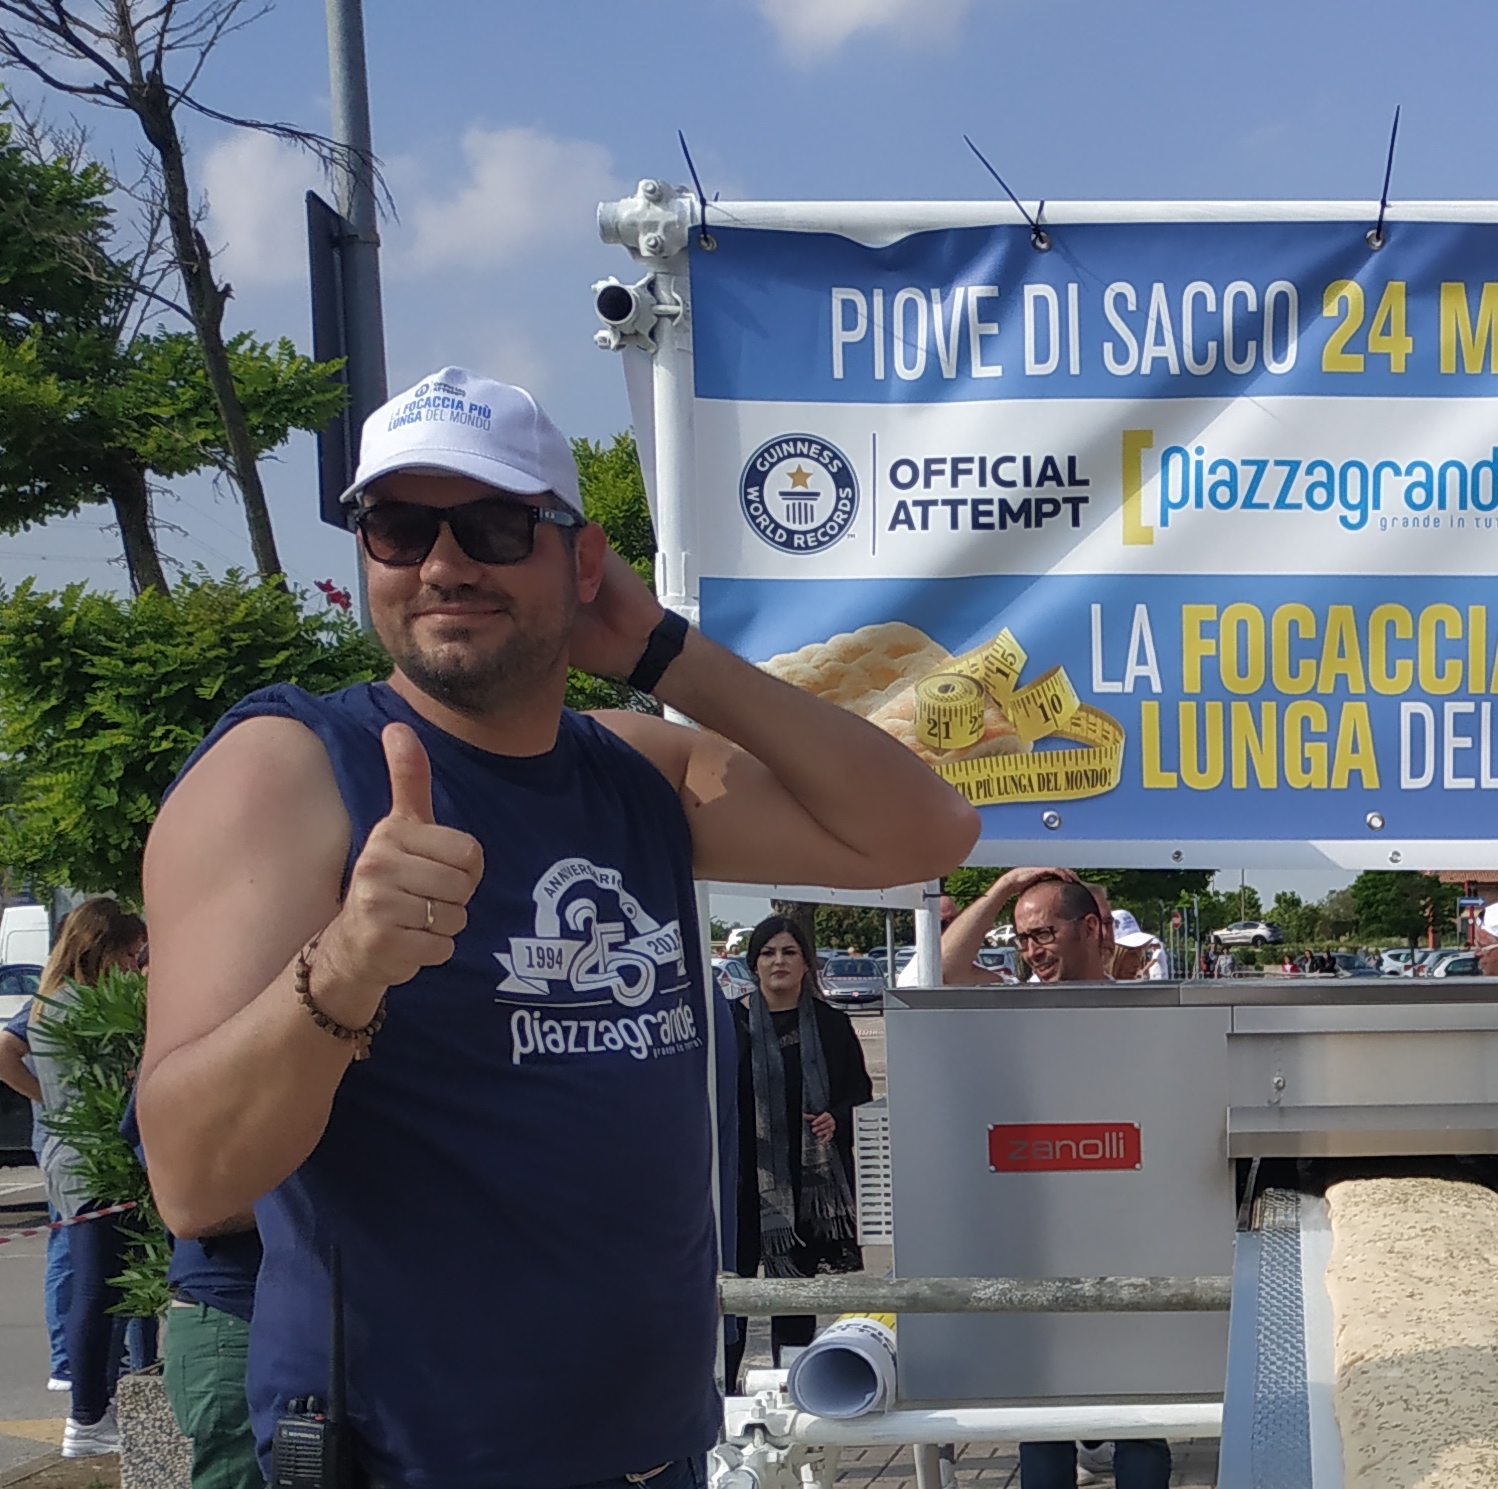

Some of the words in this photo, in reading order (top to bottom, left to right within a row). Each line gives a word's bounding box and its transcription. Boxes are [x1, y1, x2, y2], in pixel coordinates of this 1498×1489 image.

[831, 285, 1002, 380] PIOVE
[1023, 282, 1079, 377] DI
[1103, 280, 1299, 376] SACCO
[1322, 279, 1413, 374] 24
[387, 411, 422, 432] LUNGA
[426, 409, 445, 422] DEL
[450, 410, 491, 431] MONDO
[403, 396, 464, 414] FOCACCIA
[469, 402, 492, 419] PIÙ
[756, 441, 842, 473] GUINNESS
[889, 455, 1090, 490] OFFICIAL
[746, 486, 787, 543] WORLD
[793, 487, 853, 548] RECORDS
[887, 497, 1090, 533] ATTEMPT
[1380, 514, 1441, 531] grande
[1450, 514, 1466, 529] in
[1091, 603, 1162, 694] LA
[926, 717, 952, 740] 21
[1140, 700, 1381, 790] LUNGA
[975, 774, 995, 801] PIÙ
[997, 773, 1035, 796] LUNGA
[1036, 771, 1062, 793] DEL
[1064, 767, 1113, 792] MONDO!
[525, 945, 563, 971] 1994
[510, 997, 698, 1066] piazzagrande
[1008, 1131, 1126, 1161] zanolli
